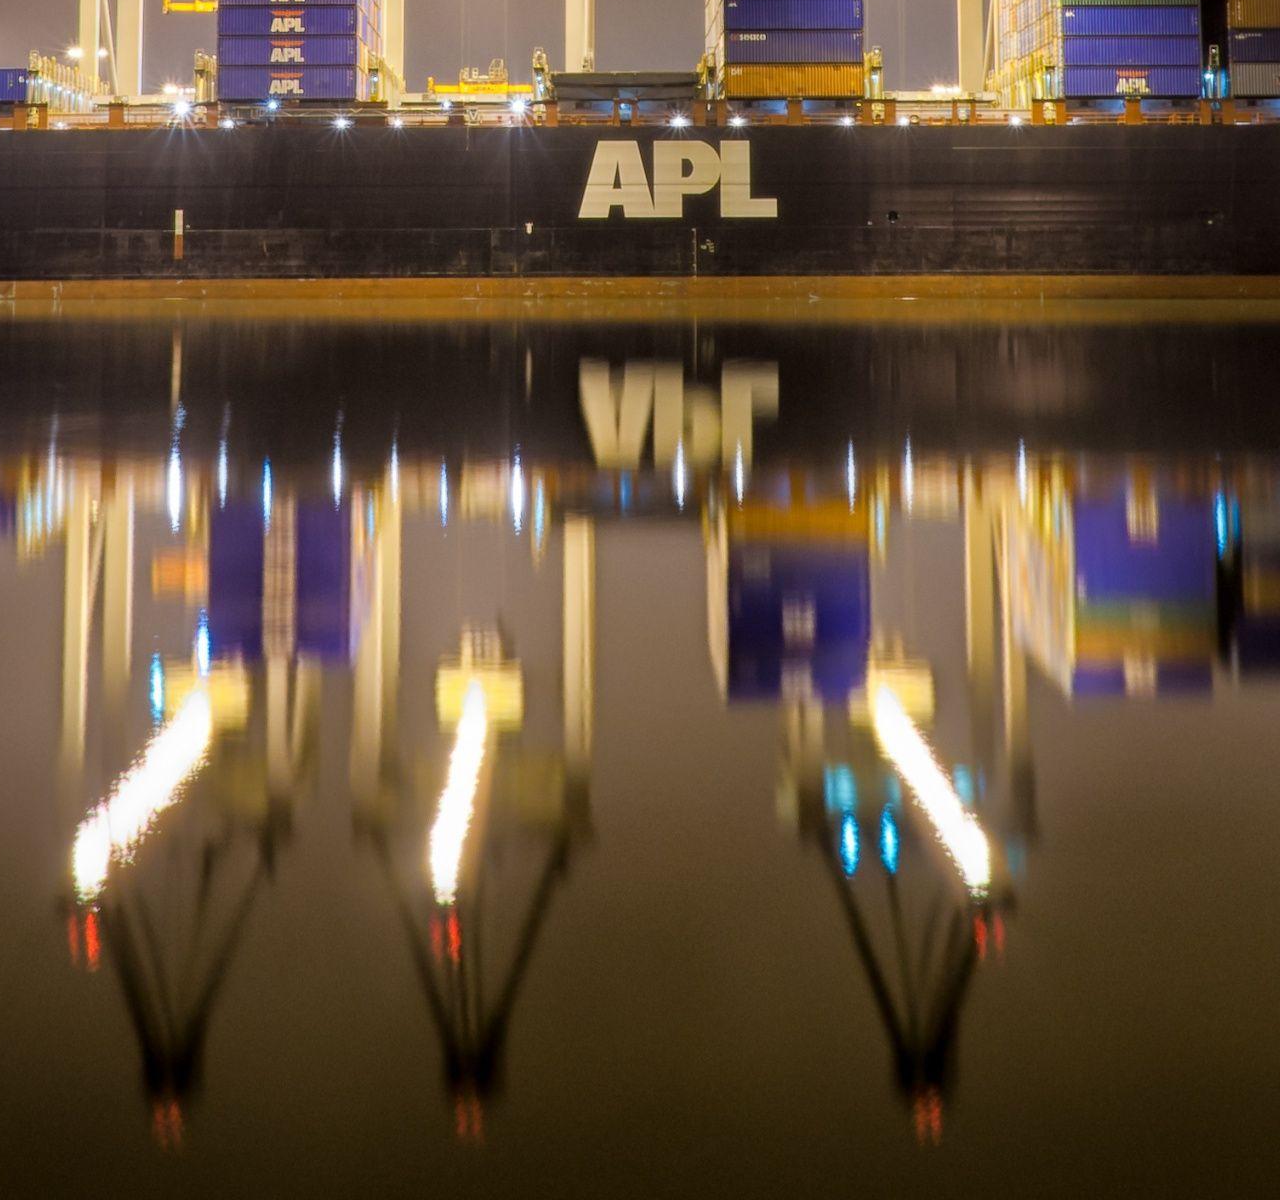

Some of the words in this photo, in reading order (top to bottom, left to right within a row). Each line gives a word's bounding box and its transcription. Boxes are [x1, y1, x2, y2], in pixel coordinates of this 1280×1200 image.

[271, 18, 305, 32] APL
[271, 48, 304, 62] APL
[269, 79, 304, 94] APL
[578, 140, 777, 218] APL
